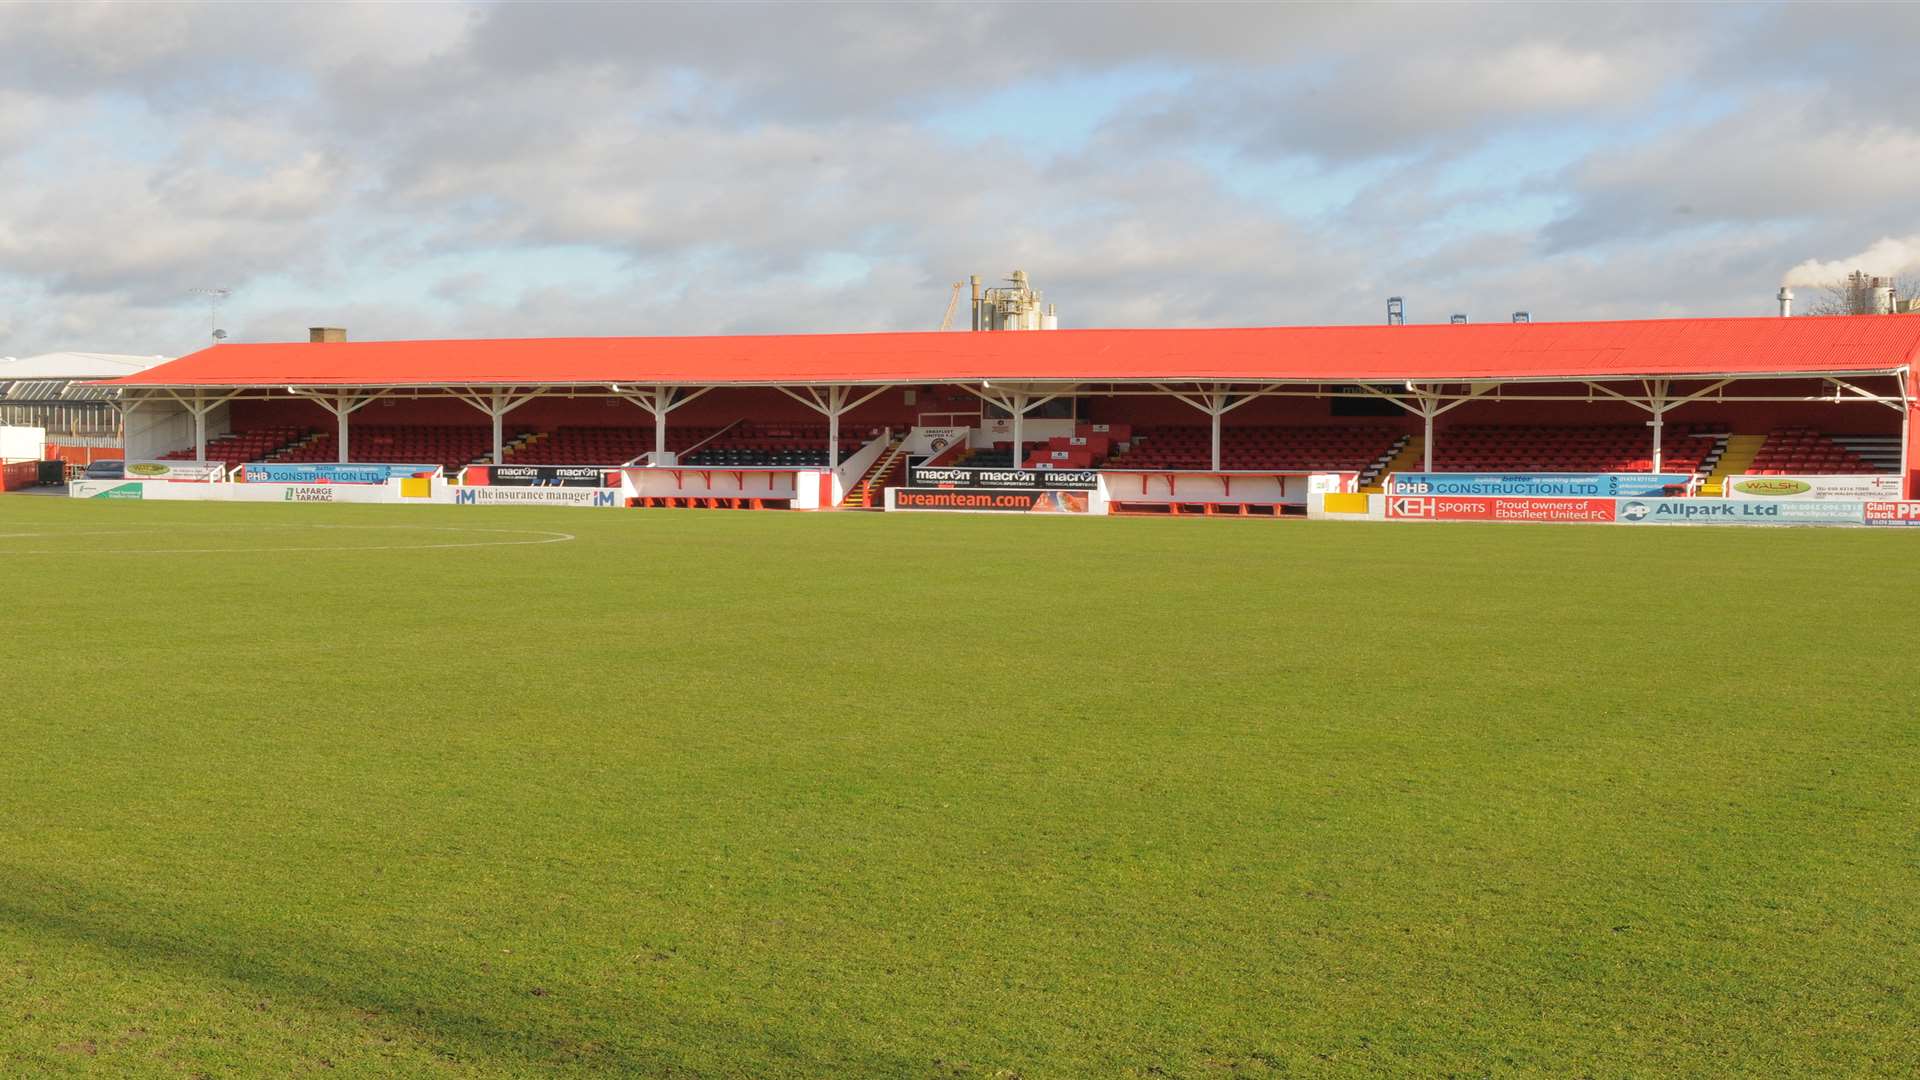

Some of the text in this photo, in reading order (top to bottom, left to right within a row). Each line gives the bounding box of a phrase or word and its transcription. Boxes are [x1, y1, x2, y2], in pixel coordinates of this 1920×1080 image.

[247, 472, 380, 481] PHB CONSTRUCTION LTD
[497, 467, 538, 476] macron
[556, 467, 598, 477] macron
[916, 470, 970, 480] macron
[980, 471, 1035, 481] macron
[1396, 483, 1598, 494] PHB CONSTRUCTION LTD
[1746, 482, 1799, 490] WALSH
[478, 488, 591, 503] the insurance manager
[898, 491, 1030, 507] breamteam.com
[1388, 497, 1486, 517] KEH SPORTS
[1496, 500, 1588, 510] Proud owners of
[1656, 503, 1778, 517] Allpark Ltd
[1867, 502, 1895, 511] Claim
[1496, 509, 1606, 519] Ebbsfleet United FC
[1867, 511, 1895, 519] back
